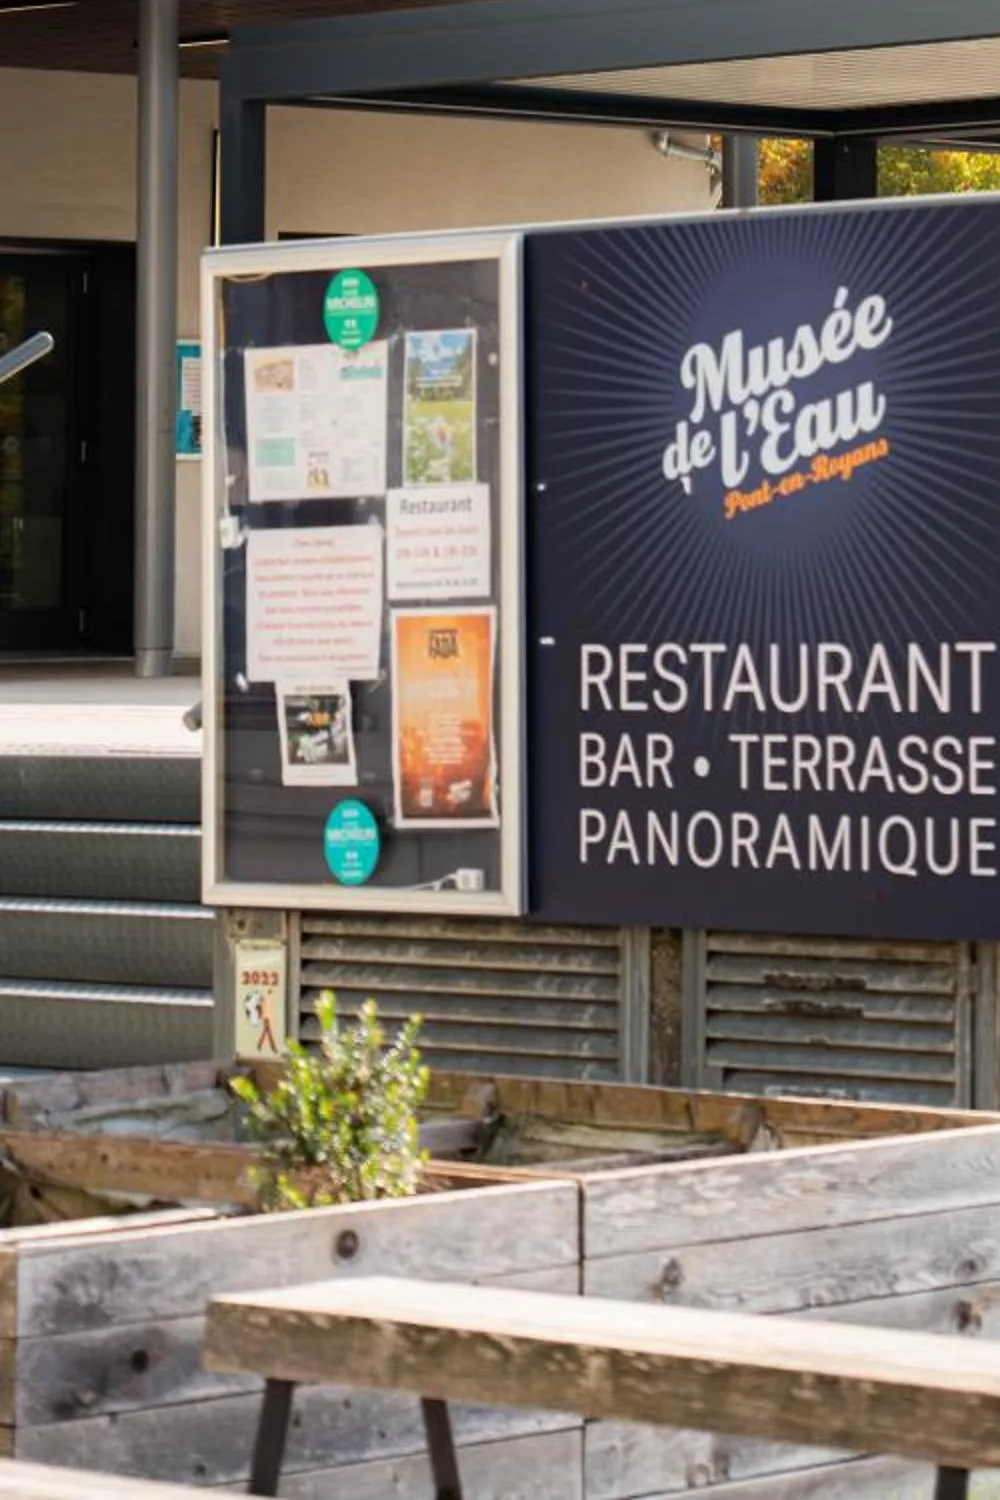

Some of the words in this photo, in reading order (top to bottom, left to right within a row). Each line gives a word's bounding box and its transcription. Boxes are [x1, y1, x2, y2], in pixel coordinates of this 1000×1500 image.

[680, 285, 893, 423] Musée
[662, 420, 716, 485] de
[723, 437, 889, 520] Pont-en-Royans
[399, 496, 472, 515] Restaurant
[582, 643, 995, 712] RESTAURANT
[581, 733, 673, 788] BAR
[729, 735, 995, 794] TERRASSE
[581, 809, 996, 876] PANORAMIQUE
